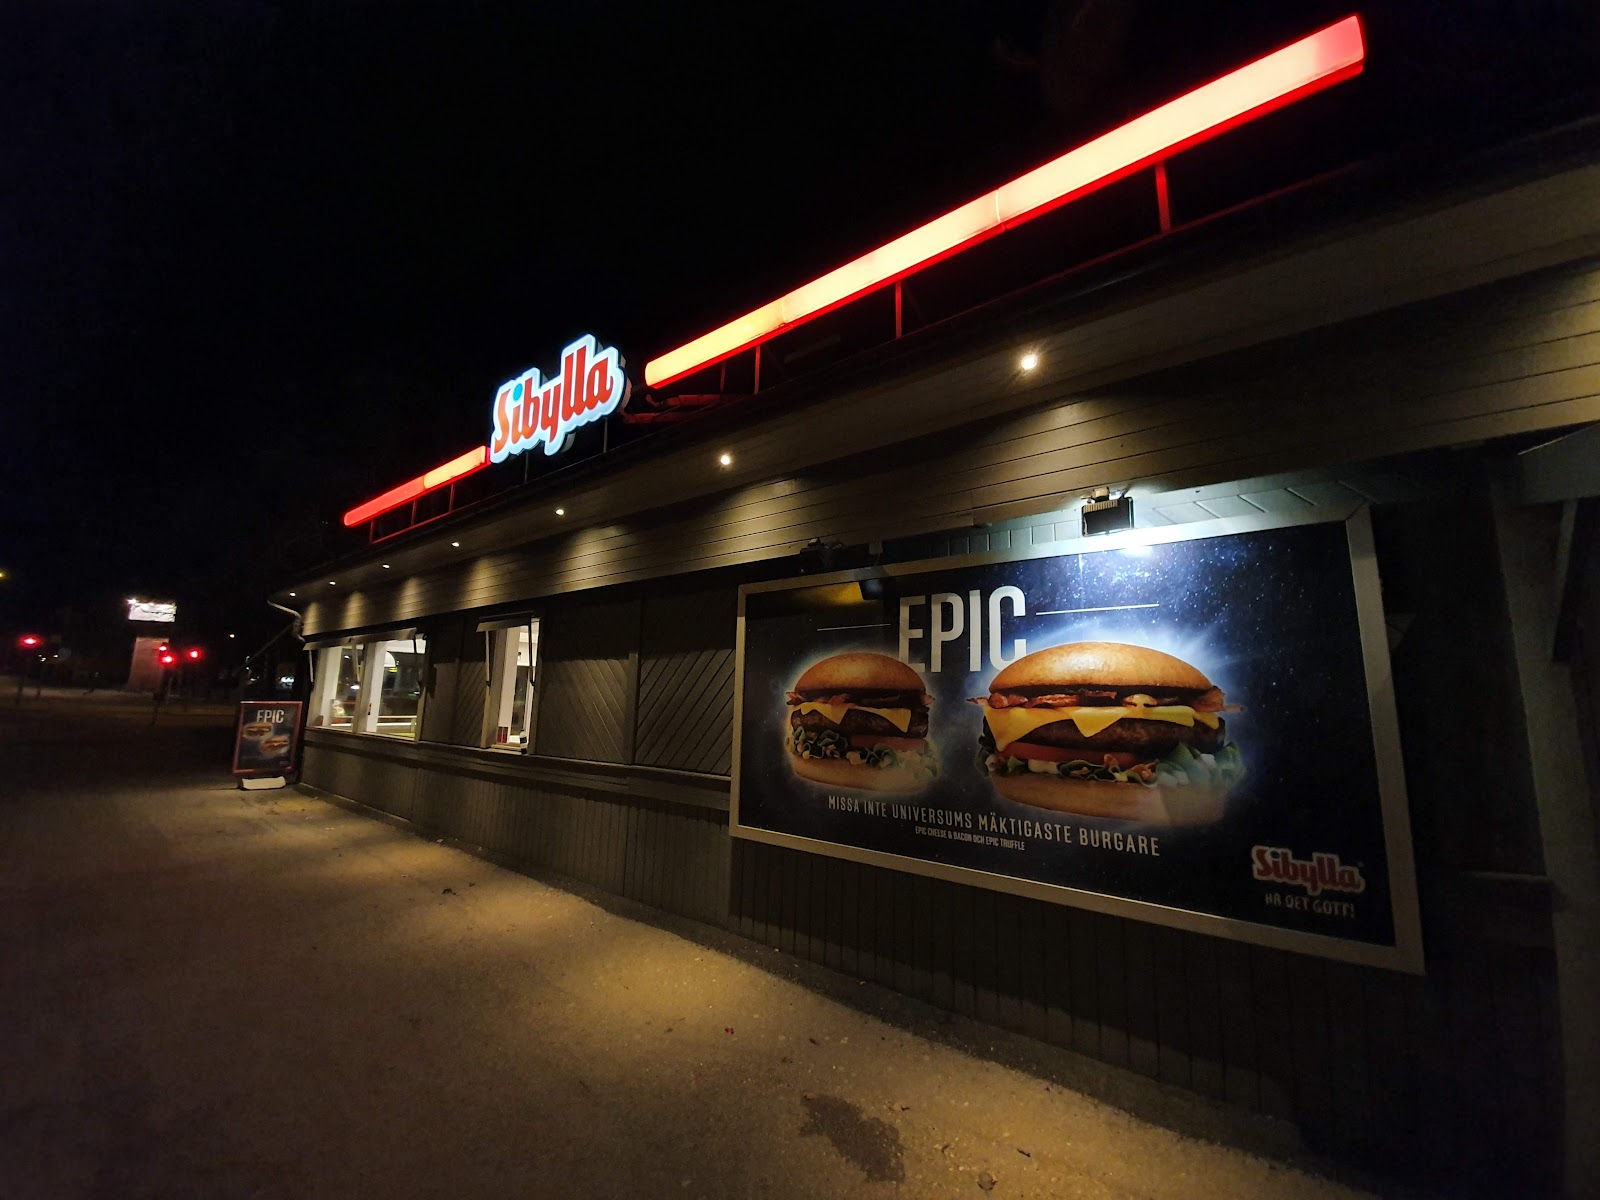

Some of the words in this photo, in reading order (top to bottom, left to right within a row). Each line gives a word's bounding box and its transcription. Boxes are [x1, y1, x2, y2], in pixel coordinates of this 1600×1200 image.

[493, 344, 615, 454] Sibylla
[898, 585, 1027, 673] EPIC
[256, 709, 285, 724] EPIC
[828, 795, 860, 813] MISSA
[863, 800, 888, 818] INTE
[892, 803, 973, 829] UNIVERSUMS
[978, 811, 1072, 844] MÄKTIGASTE
[1079, 827, 1161, 857] BURGARE
[914, 825, 927, 836] EPIC
[927, 827, 948, 839] CHEESE
[953, 831, 973, 843] BACON
[986, 836, 1000, 847] EPIC
[1000, 838, 1026, 851] TRUFFLE
[1254, 848, 1362, 893] Sibylla
